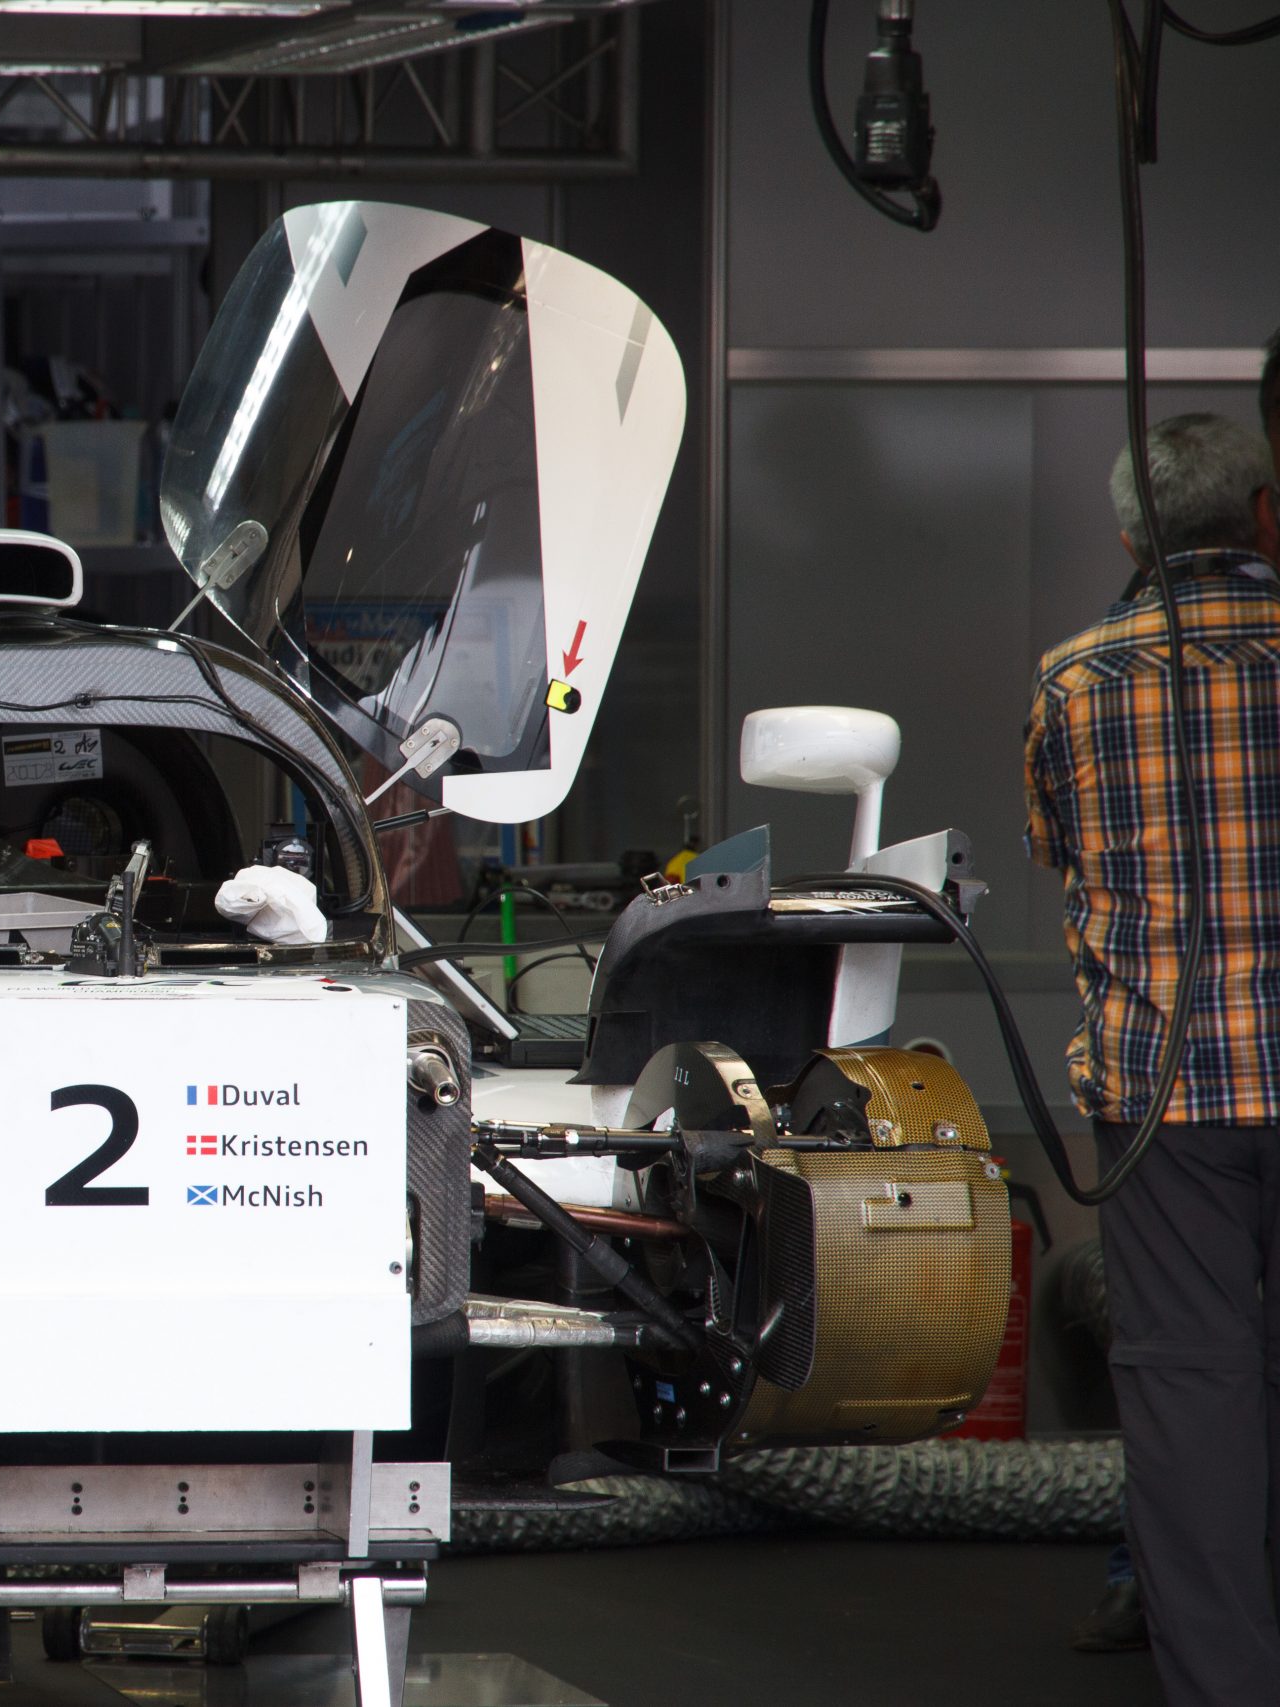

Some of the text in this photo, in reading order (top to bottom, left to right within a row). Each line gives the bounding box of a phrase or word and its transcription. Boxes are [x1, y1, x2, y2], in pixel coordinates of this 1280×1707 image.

[54, 740, 66, 754] 2
[222, 1082, 300, 1106] Duval
[45, 1083, 149, 1206] 2
[222, 1134, 368, 1157] Kristensen
[222, 1184, 323, 1207] McNish
